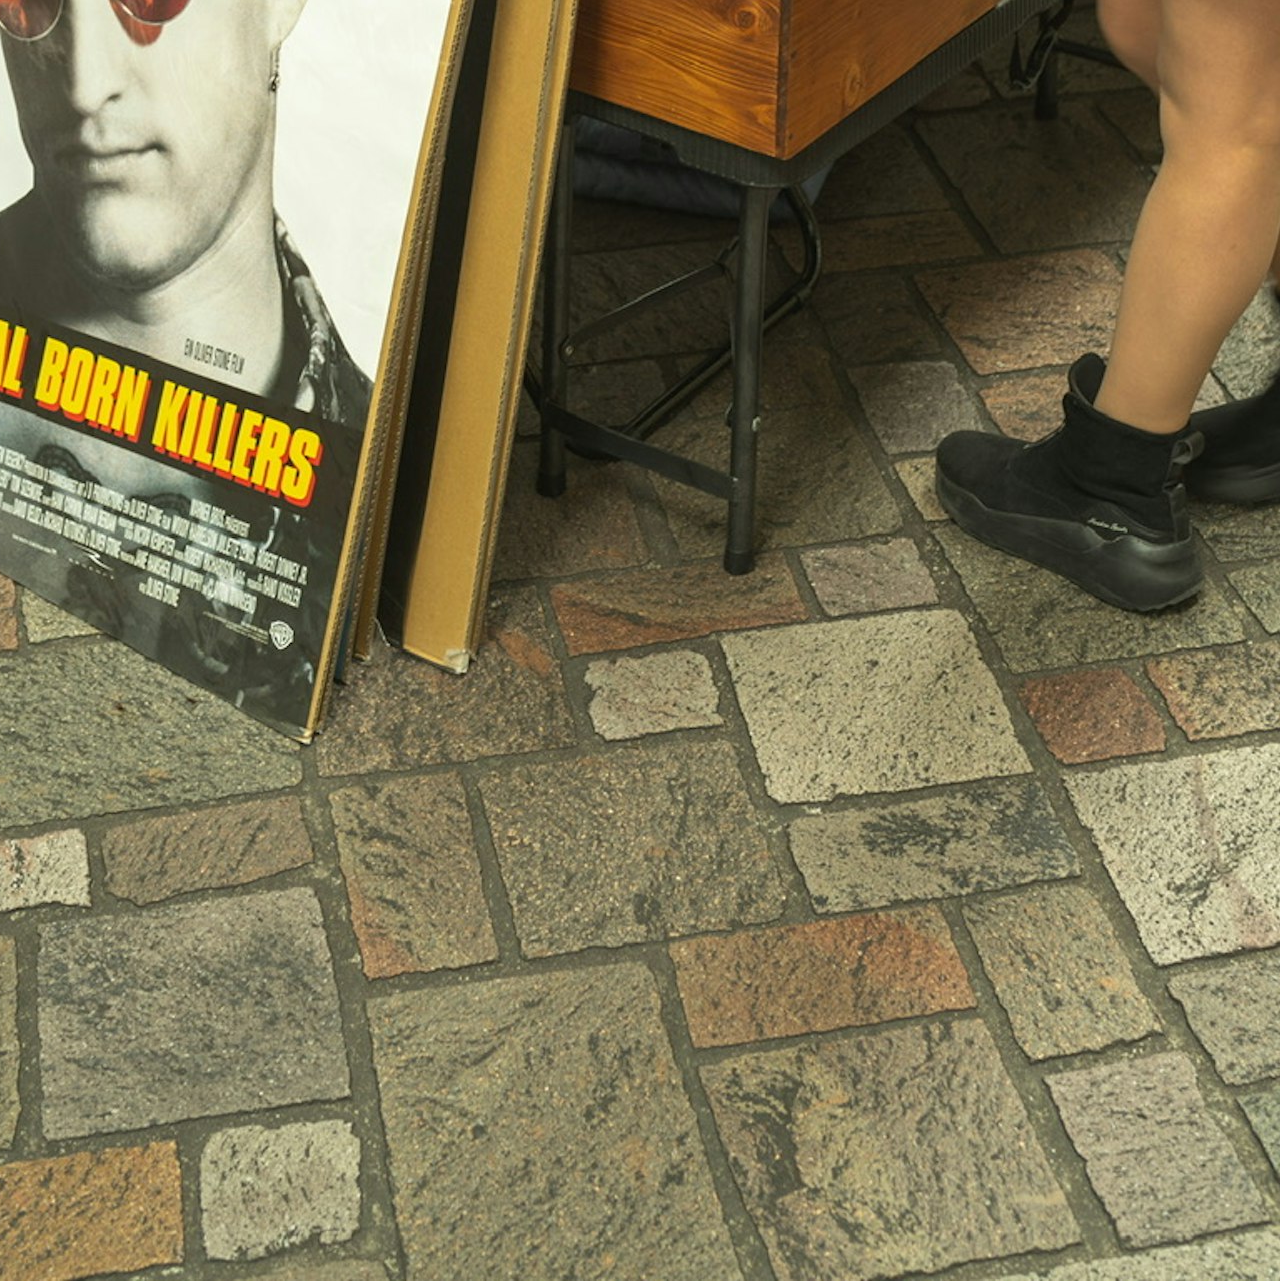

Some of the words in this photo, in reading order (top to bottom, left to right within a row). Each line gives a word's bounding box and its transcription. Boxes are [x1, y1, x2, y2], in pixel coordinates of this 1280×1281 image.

[213, 347, 232, 371] STONE
[230, 352, 245, 376] FILM
[34, 336, 152, 443] BORN
[151, 379, 324, 508] KILLERS
